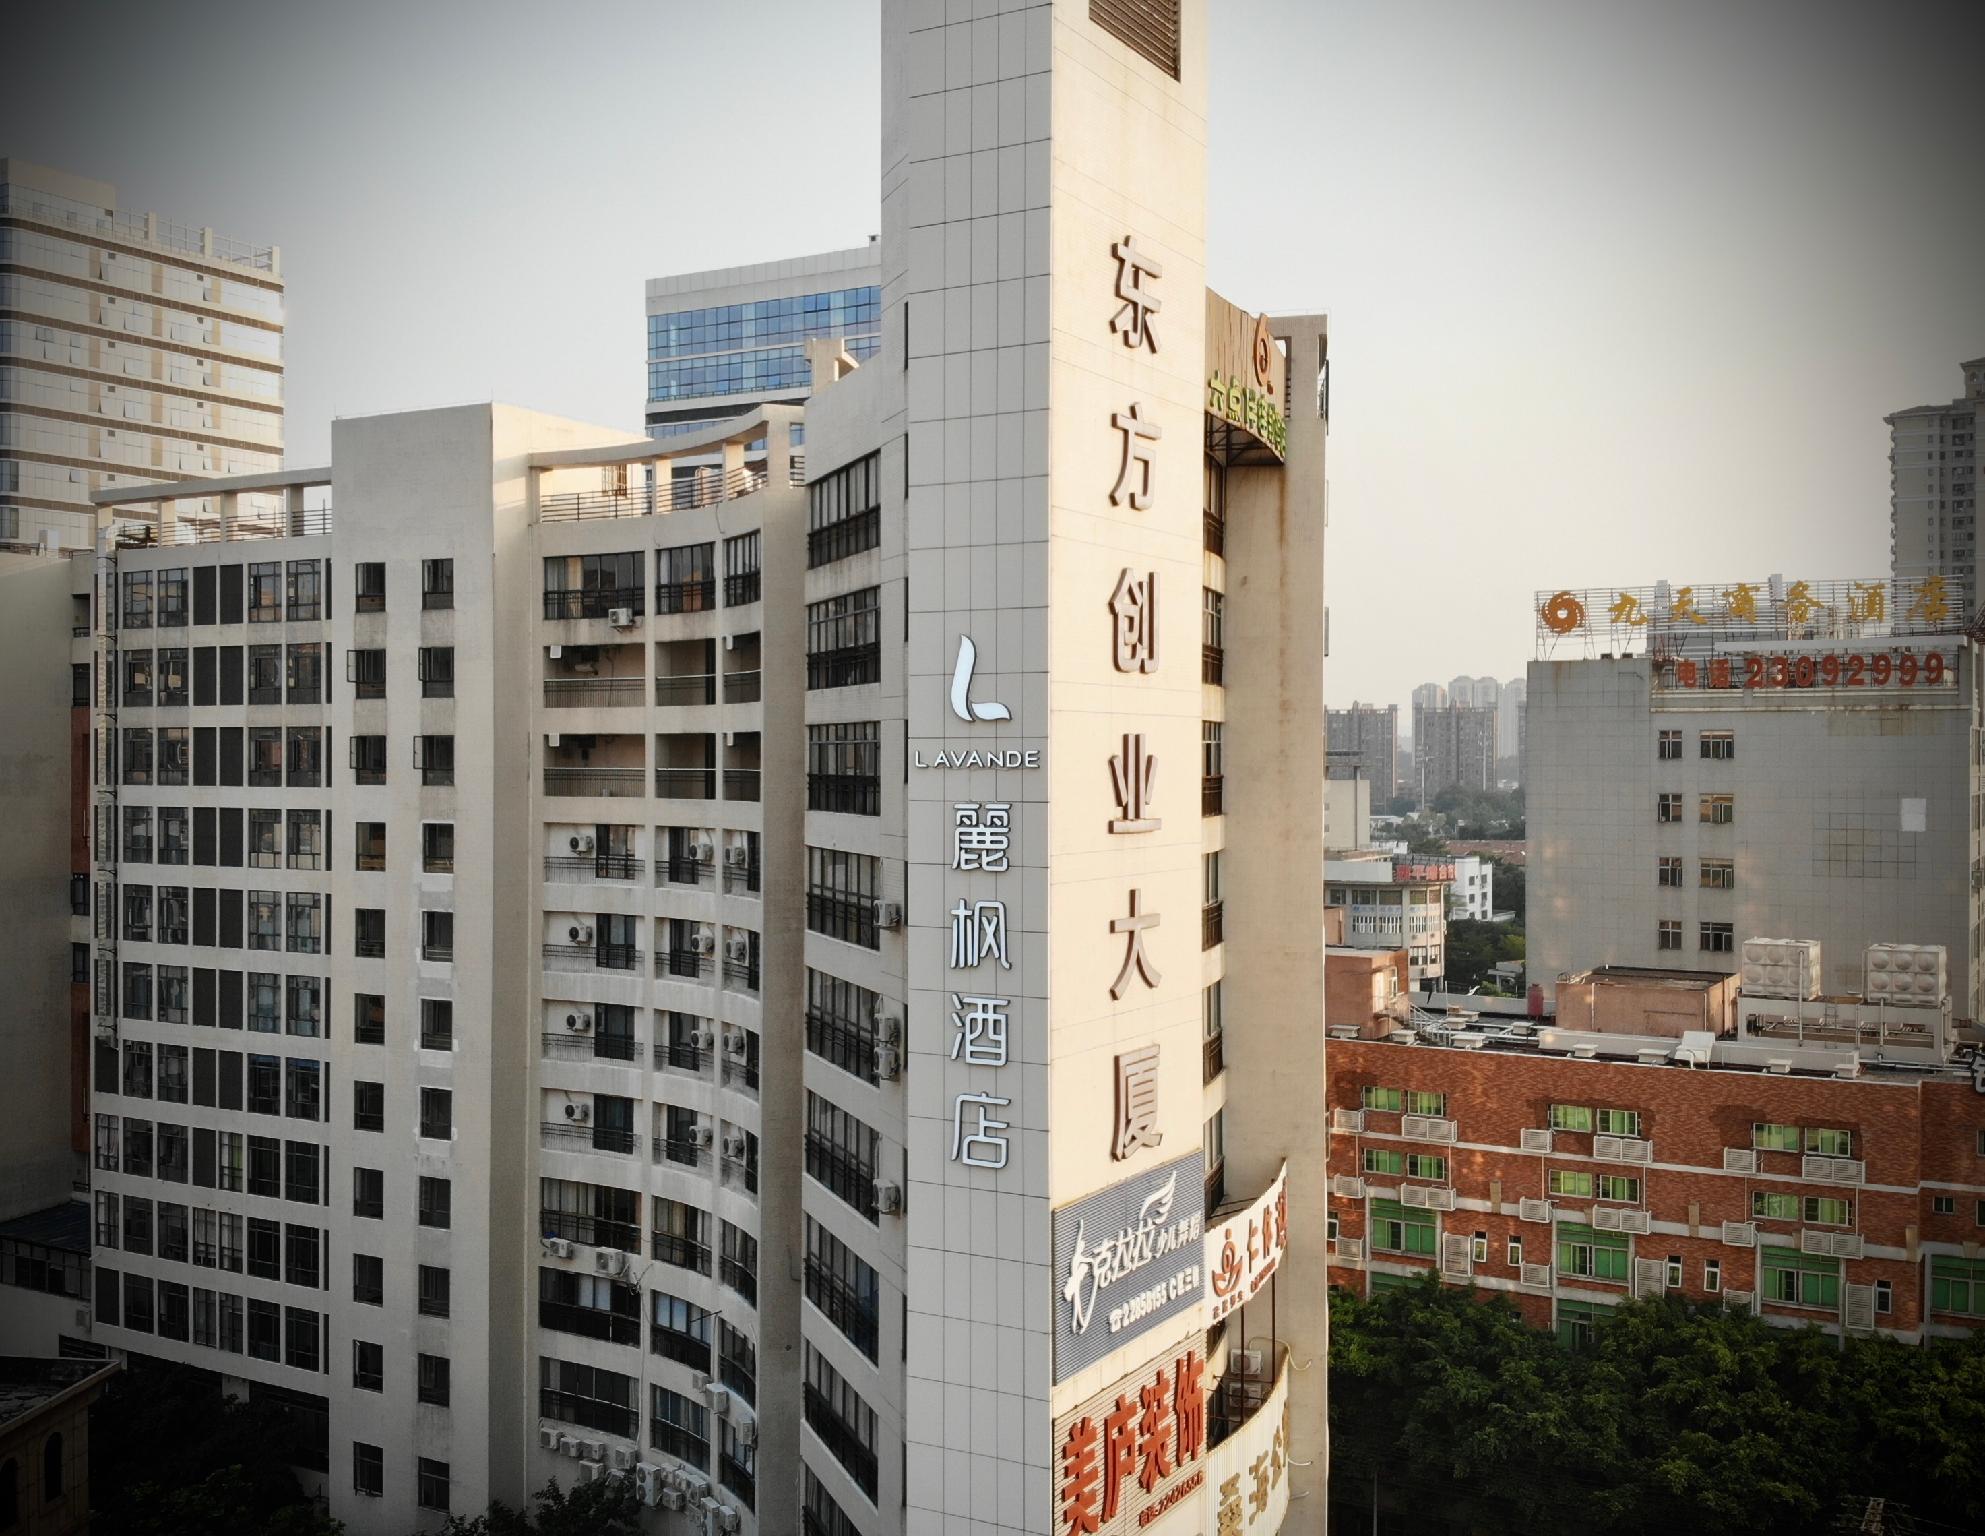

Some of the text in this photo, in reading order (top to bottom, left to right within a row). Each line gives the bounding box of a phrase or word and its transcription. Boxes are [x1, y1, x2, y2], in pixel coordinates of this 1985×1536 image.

[1607, 575, 1951, 625] 九天商务酒店
[1109, 234, 1162, 1162] 东方创业大厦
[914, 750, 1040, 769] LAVANDE
